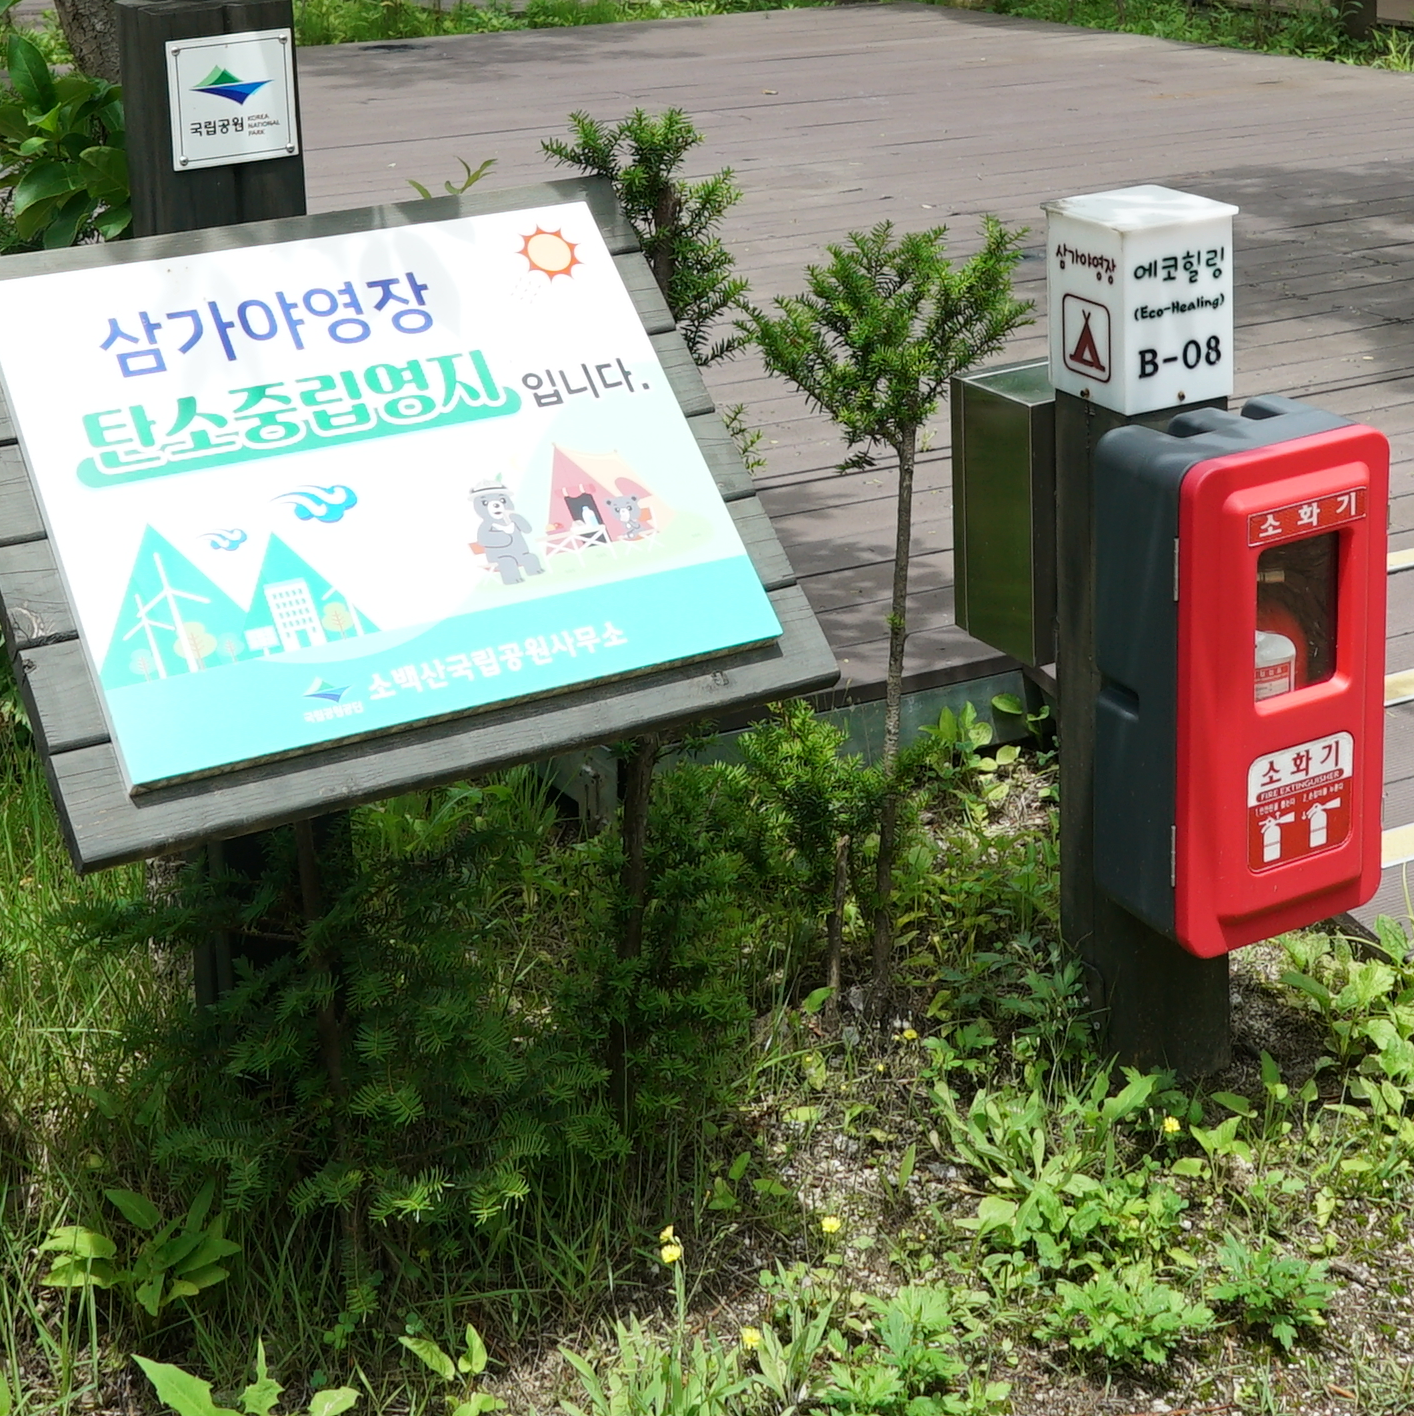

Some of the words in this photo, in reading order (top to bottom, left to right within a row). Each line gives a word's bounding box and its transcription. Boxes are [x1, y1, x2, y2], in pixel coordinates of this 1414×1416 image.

[190, 116, 244, 137] 국립공원
[247, 113, 269, 122] KOREA
[248, 119, 280, 129] NATIONAL
[1056, 243, 1116, 285] 삼가야영장
[1134, 247, 1224, 284] 에코힐링
[99, 272, 435, 378] 삼가야영장
[1134, 293, 1225, 321] (Eco-Healing)
[1138, 335, 1221, 379] B-08
[82, 350, 503, 472] 탄소중립영지
[521, 358, 650, 408] 입니다.
[368, 621, 628, 700] 소백산국립공원사무소
[1261, 740, 1339, 787] 소화기
[1261, 789, 1278, 801] FIRE
[1280, 770, 1340, 794] EXTINGUISHER
